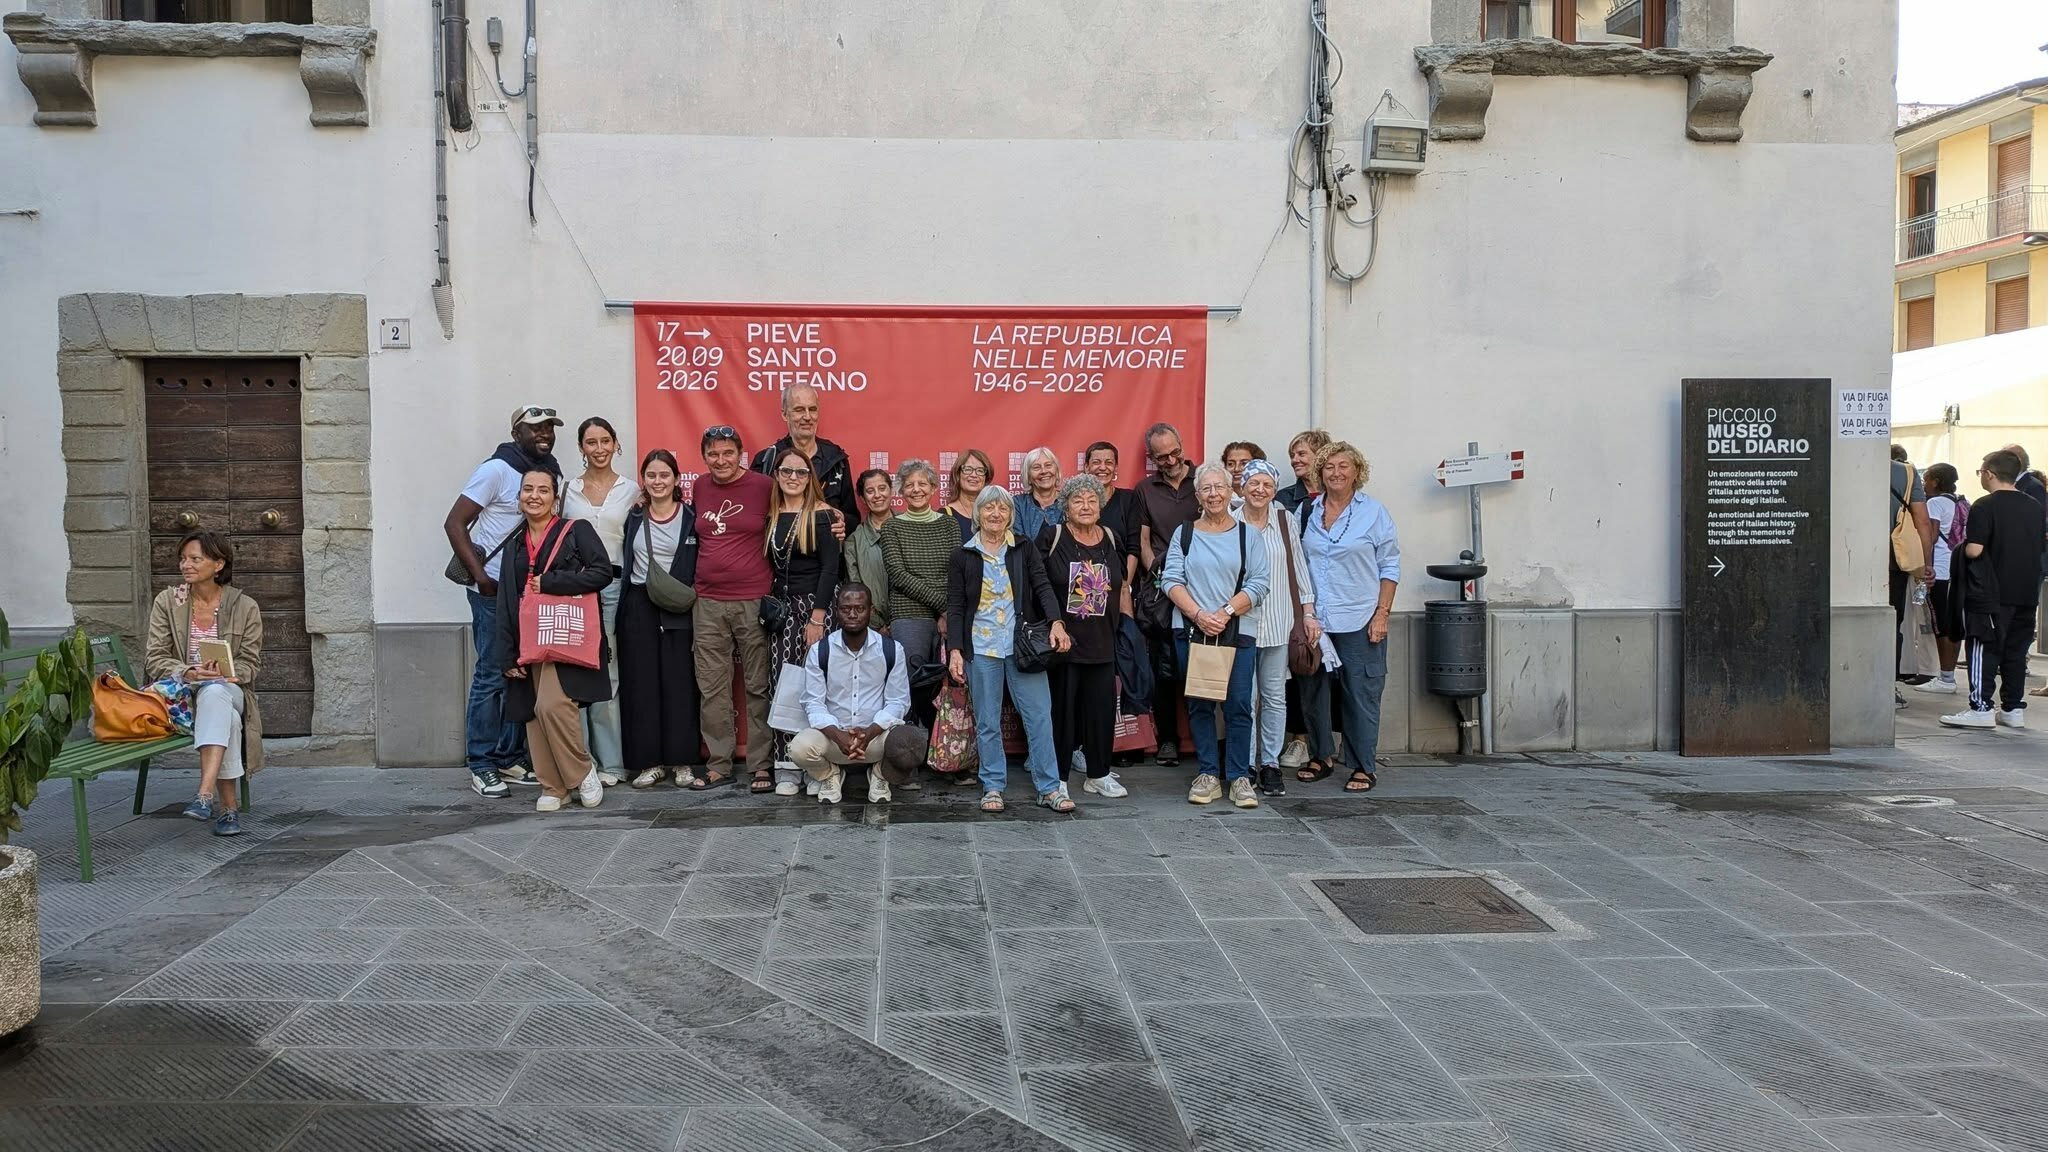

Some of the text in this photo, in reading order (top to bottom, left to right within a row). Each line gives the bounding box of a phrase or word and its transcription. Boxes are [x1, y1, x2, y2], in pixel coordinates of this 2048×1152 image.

[392, 326, 400, 340] 2
[657, 321, 680, 342] 17
[747, 323, 821, 344] PIEVE
[972, 324, 1173, 345] LA REPUBBLICA
[656, 345, 724, 367] 20.09
[747, 347, 837, 367] SANTO
[972, 349, 1187, 369] NELLE MEMORIE
[656, 370, 719, 391] 2026
[747, 371, 867, 392] STEFANO
[1842, 392, 1889, 402] VIA DI FUGA
[1708, 408, 1777, 423] PICCOLO
[1841, 418, 1888, 428] VIA DI FUGA
[1708, 424, 1772, 439] MUSEO
[1708, 438, 1810, 454] DEL DIARIO
[1741, 497, 1759, 506] degli
[1770, 520, 1796, 528] history,
[1708, 530, 1736, 538] through
